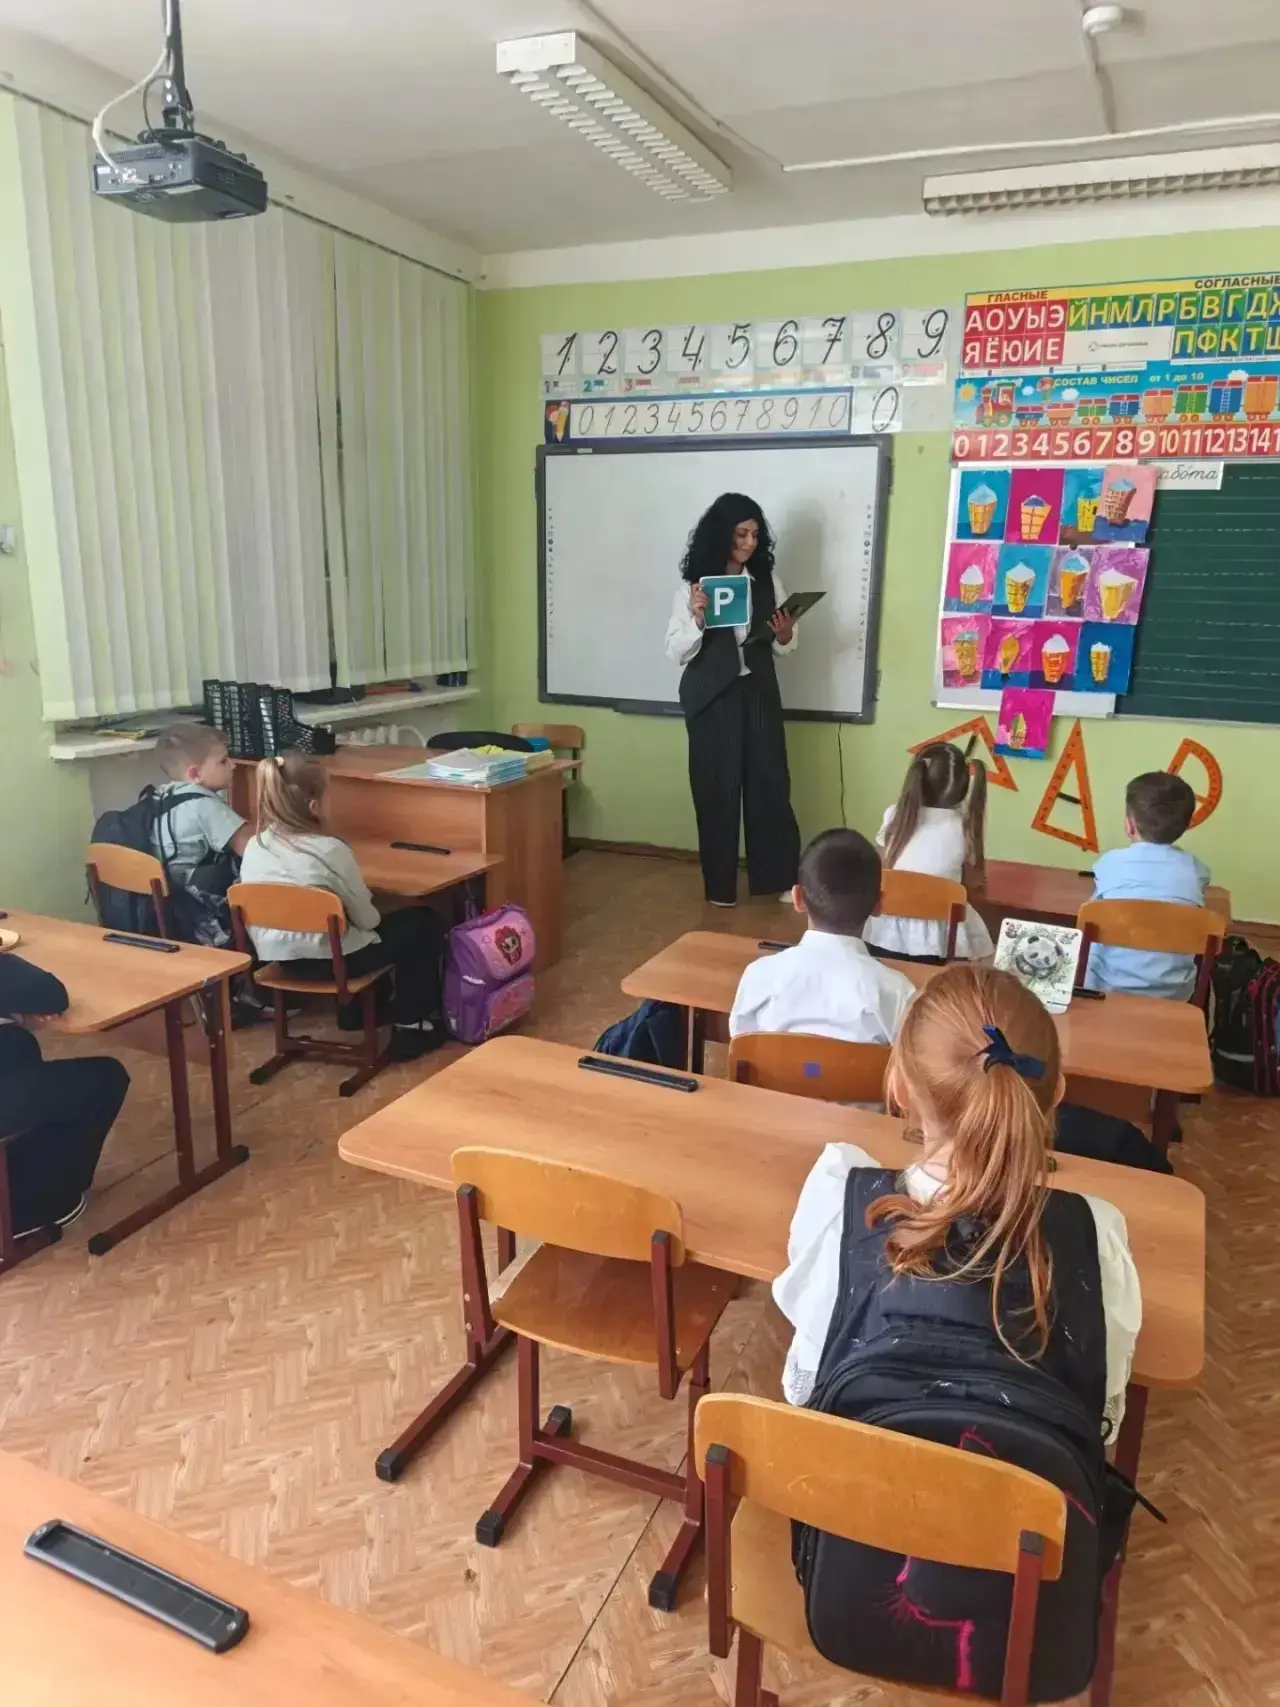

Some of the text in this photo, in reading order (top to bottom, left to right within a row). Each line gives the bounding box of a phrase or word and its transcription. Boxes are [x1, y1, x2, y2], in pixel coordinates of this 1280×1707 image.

[987, 291, 1048, 303] ГЛАСНЫЕ
[557, 309, 949, 376] 1 2 3 4 5 6 7 8 9
[1053, 376, 1097, 387] СОСТАВ
[1101, 374, 1139, 384] ЧИСЕЛ
[1191, 372, 1204, 380] 10
[954, 435, 970, 457] 0
[977, 434, 987, 457] 1
[992, 434, 1009, 457] 2
[1013, 433, 1029, 456] 3
[1032, 432, 1049, 456] 4
[1053, 431, 1069, 455] 5
[1073, 431, 1091, 455] 6
[1096, 431, 1113, 455] 7
[1116, 430, 1133, 454] 8
[1138, 430, 1155, 454] 9
[1160, 429, 1179, 454] 10
[1182, 429, 1201, 453] 11
[1204, 428, 1225, 453] 12
[1226, 428, 1247, 453] 13
[1249, 427, 1270, 452] 14
